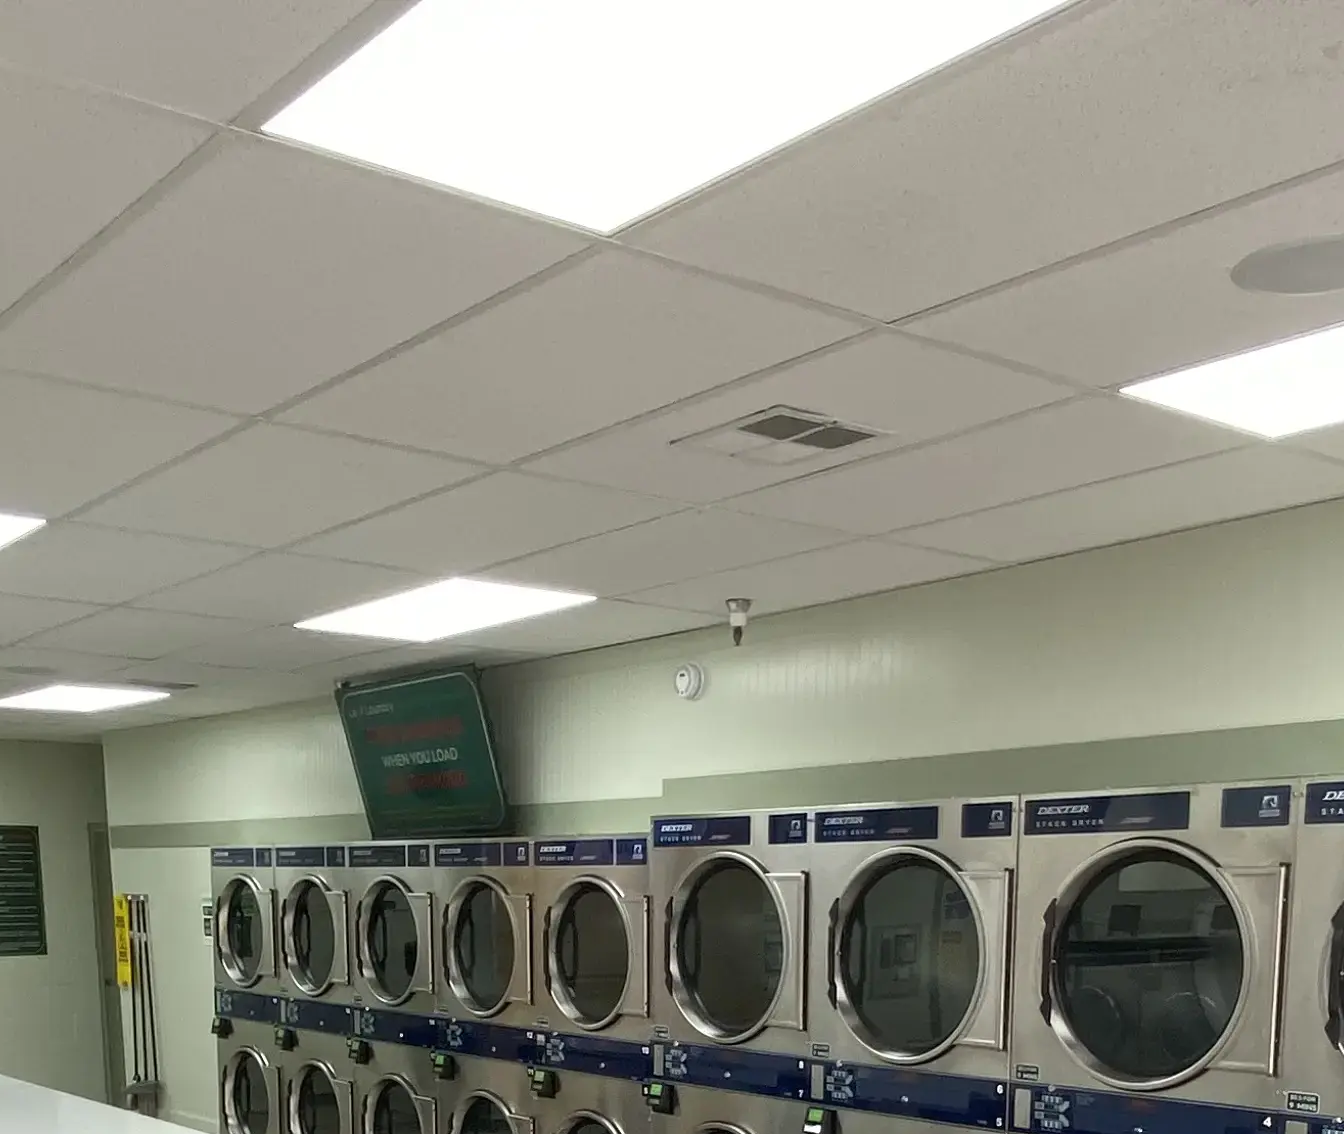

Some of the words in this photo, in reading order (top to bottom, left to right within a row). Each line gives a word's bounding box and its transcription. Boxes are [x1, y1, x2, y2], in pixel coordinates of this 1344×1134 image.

[381, 753, 409, 768] WHEN
[410, 750, 431, 765] YOU
[431, 747, 458, 762] LOAD
[1037, 804, 1090, 815] DEXTER
[823, 816, 863, 826] DEXTER
[660, 824, 692, 832] DEXTER
[798, 1089, 804, 1098] 7
[997, 1085, 1004, 1094] 6
[996, 1117, 1003, 1127] 5
[1263, 1117, 1272, 1127] 4
